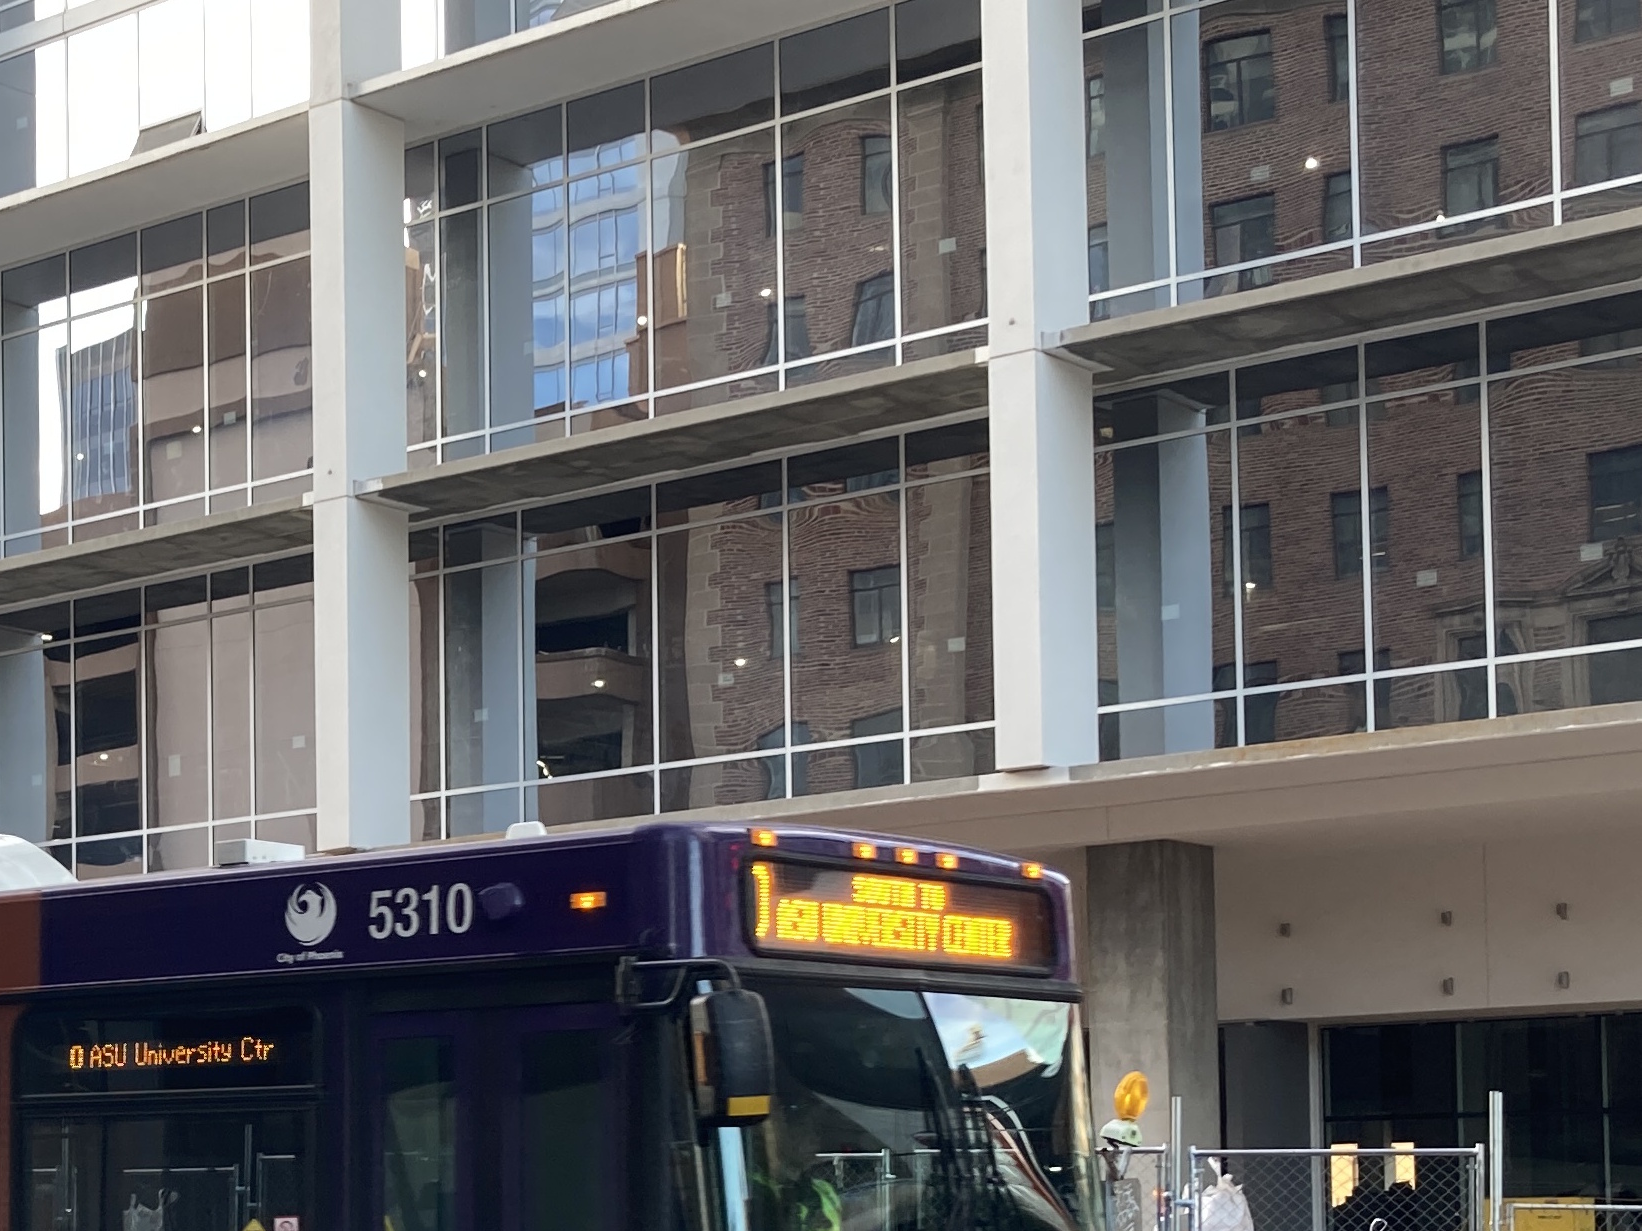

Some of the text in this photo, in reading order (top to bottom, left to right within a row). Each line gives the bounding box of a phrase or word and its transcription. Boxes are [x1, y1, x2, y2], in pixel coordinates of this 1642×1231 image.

[367, 882, 473, 940] 5310
[89, 1042, 128, 1068] ASU
[134, 1041, 233, 1066] University
[240, 1036, 275, 1062] Ctr
